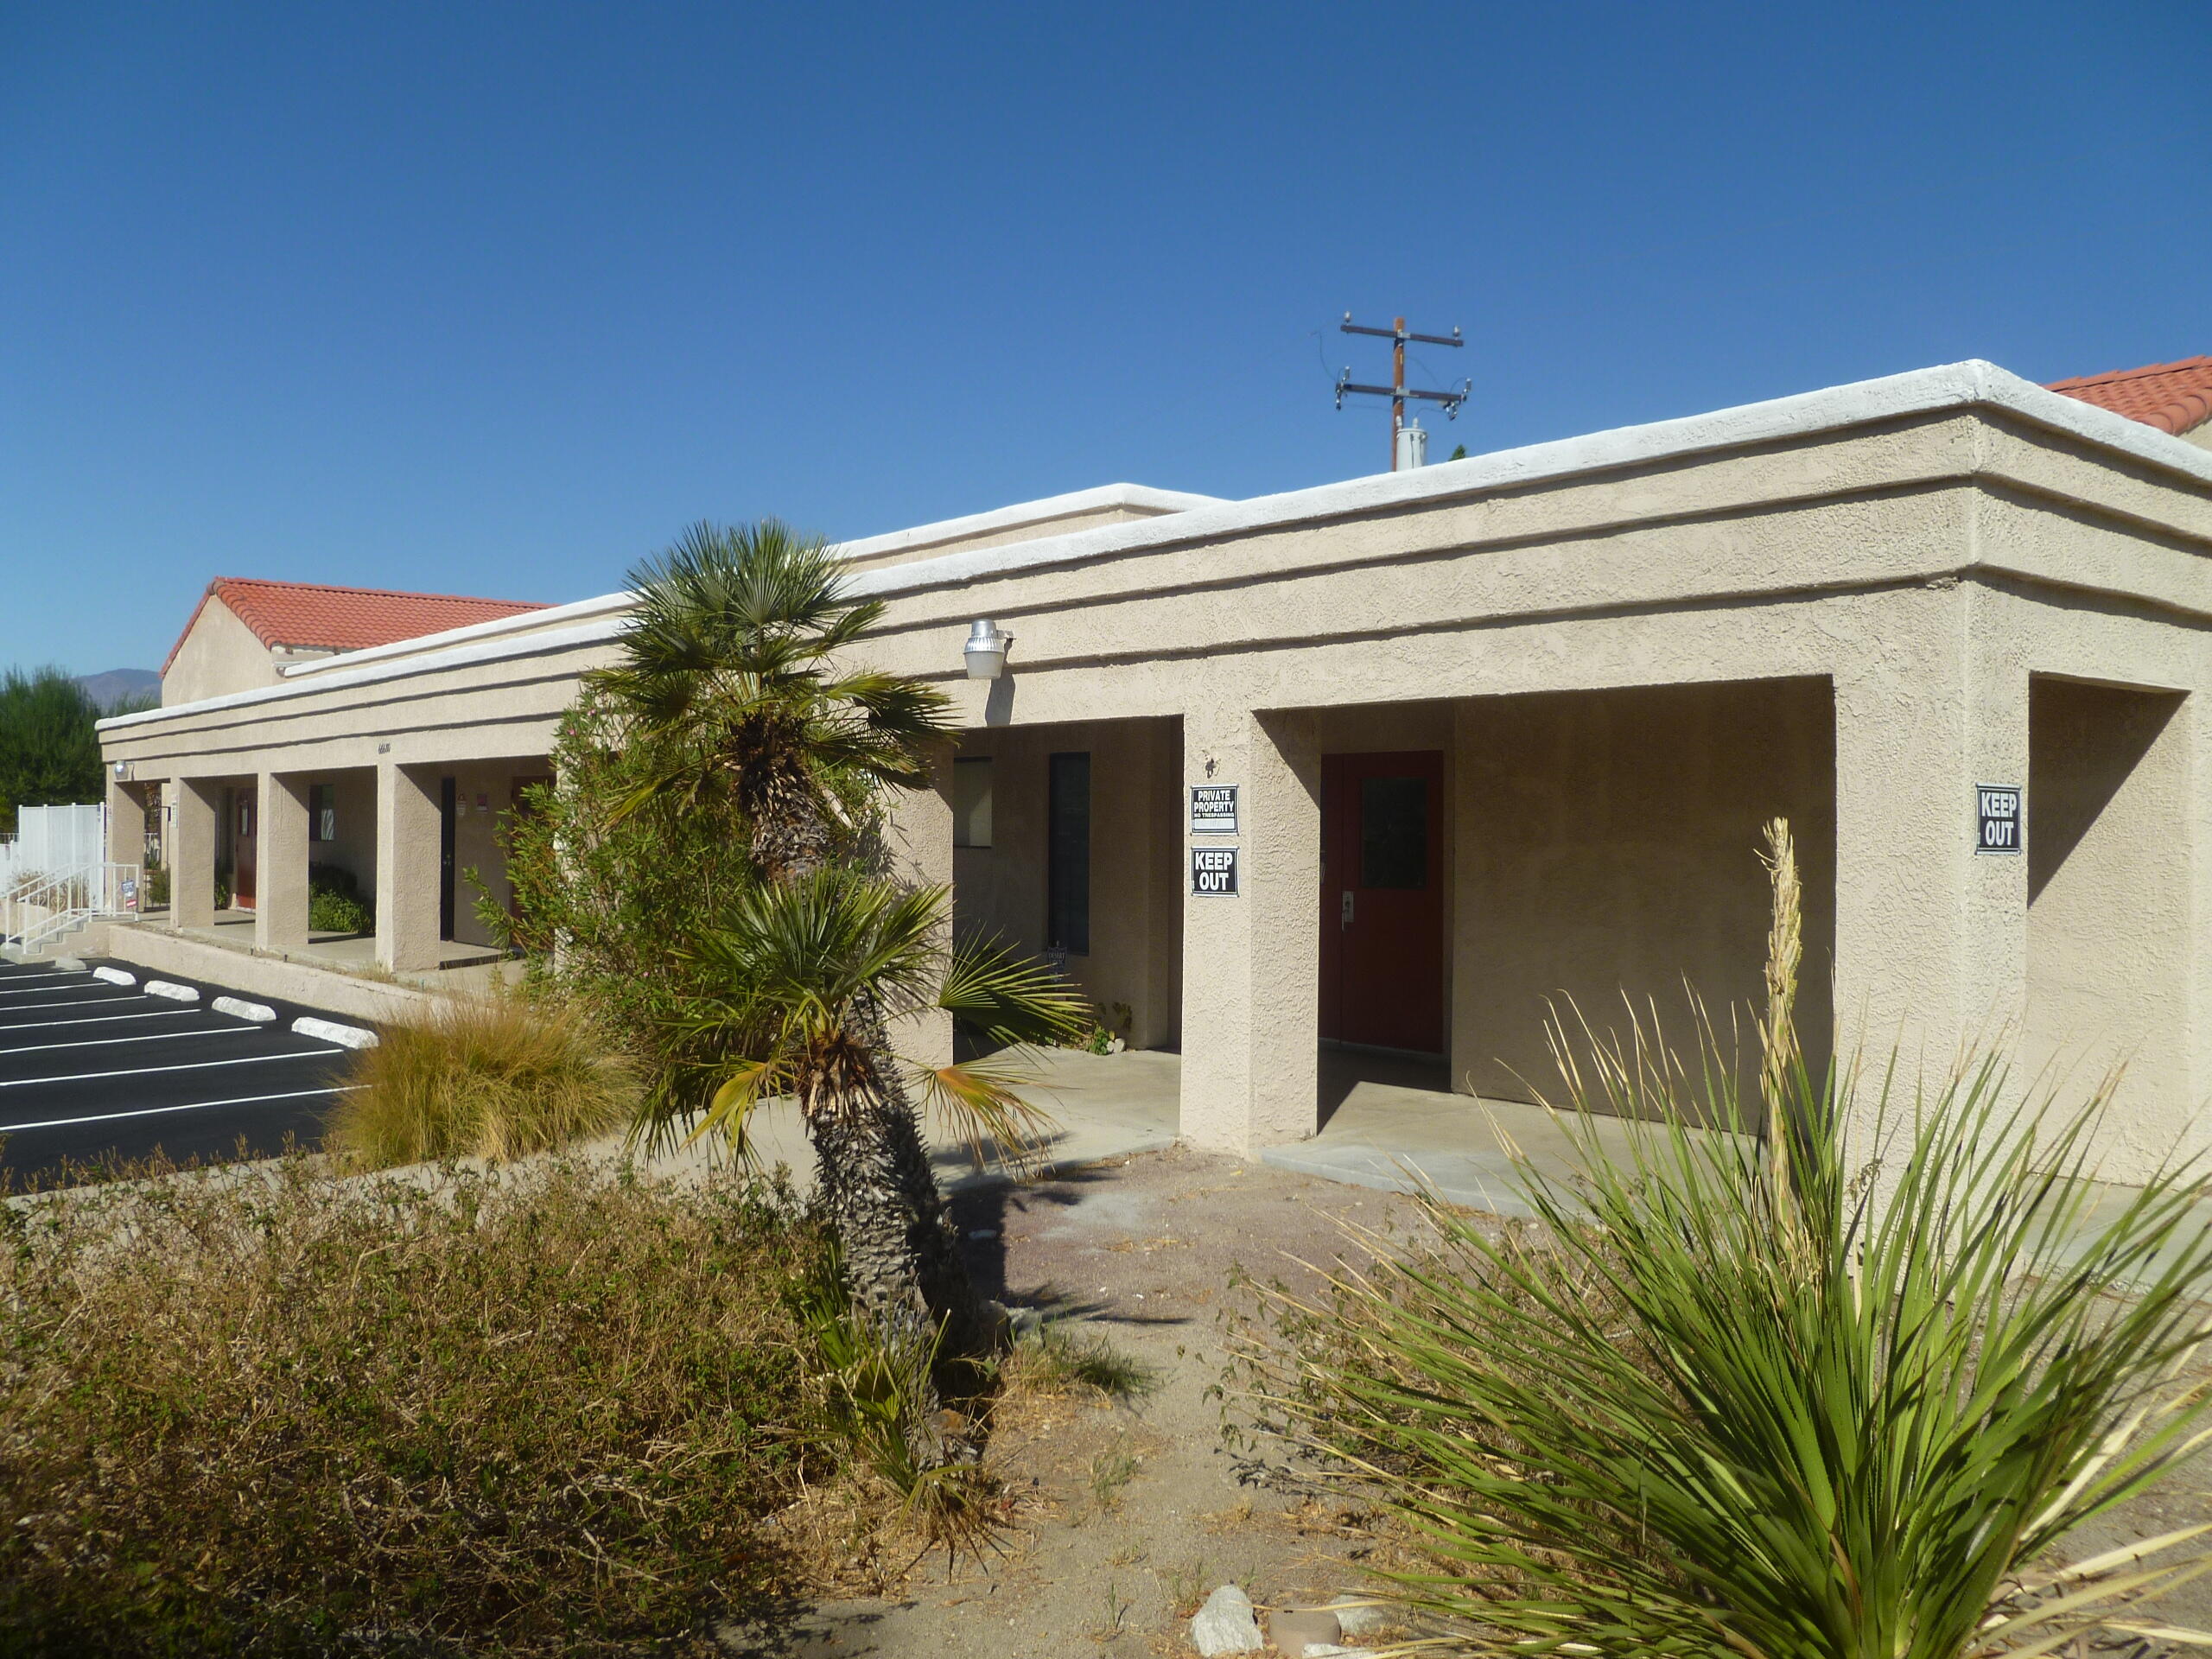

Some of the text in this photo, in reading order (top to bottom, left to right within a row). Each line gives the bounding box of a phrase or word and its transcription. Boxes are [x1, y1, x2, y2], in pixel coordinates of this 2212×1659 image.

[1198, 790, 1230, 801] PRIVATE
[1981, 791, 2018, 817] KEEP
[1194, 800, 1234, 812] PROPERTY
[1986, 820, 2014, 846] OUT
[1195, 852, 1232, 870] KEEP
[1199, 872, 1229, 891] OUT
